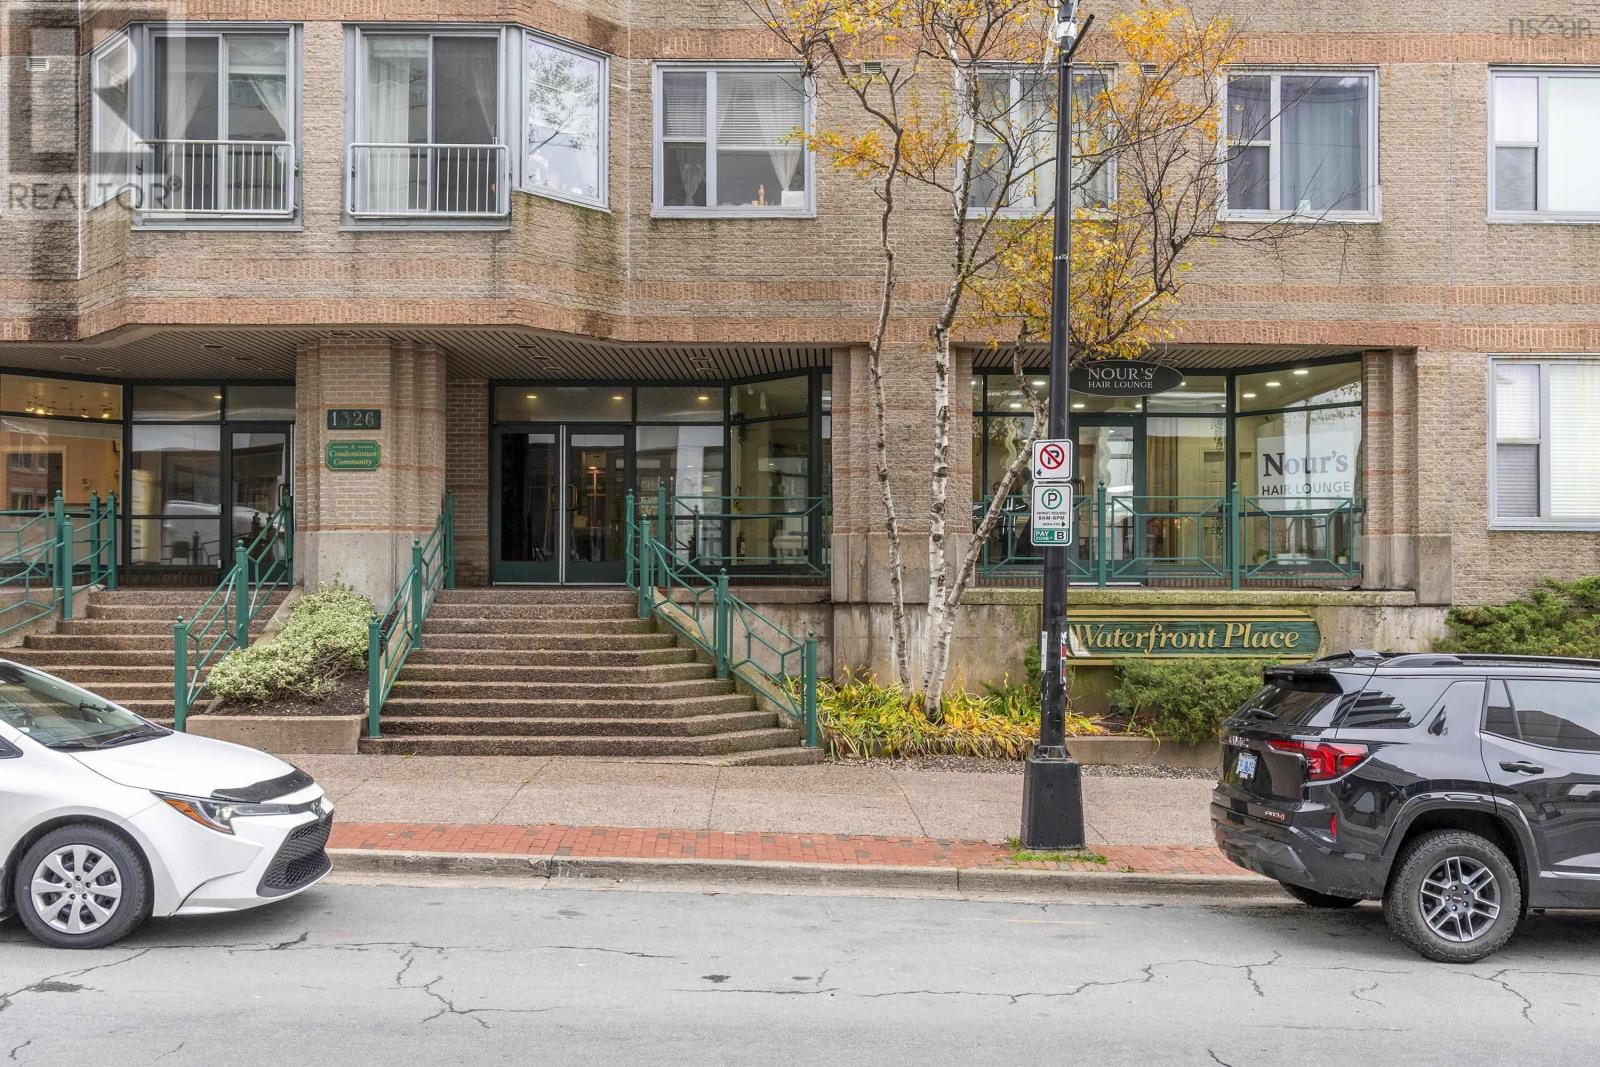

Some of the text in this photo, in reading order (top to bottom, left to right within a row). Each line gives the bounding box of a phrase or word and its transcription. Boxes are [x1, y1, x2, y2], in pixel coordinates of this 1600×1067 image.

[1088, 367, 1153, 380] NOUR'S
[1114, 381, 1153, 389] LOUNGE
[1263, 450, 1348, 477] Nour's
[1262, 481, 1351, 496] HAIR LOUNGE
[1057, 532, 1064, 540] B
[1074, 622, 1299, 656] Waterfront Place
